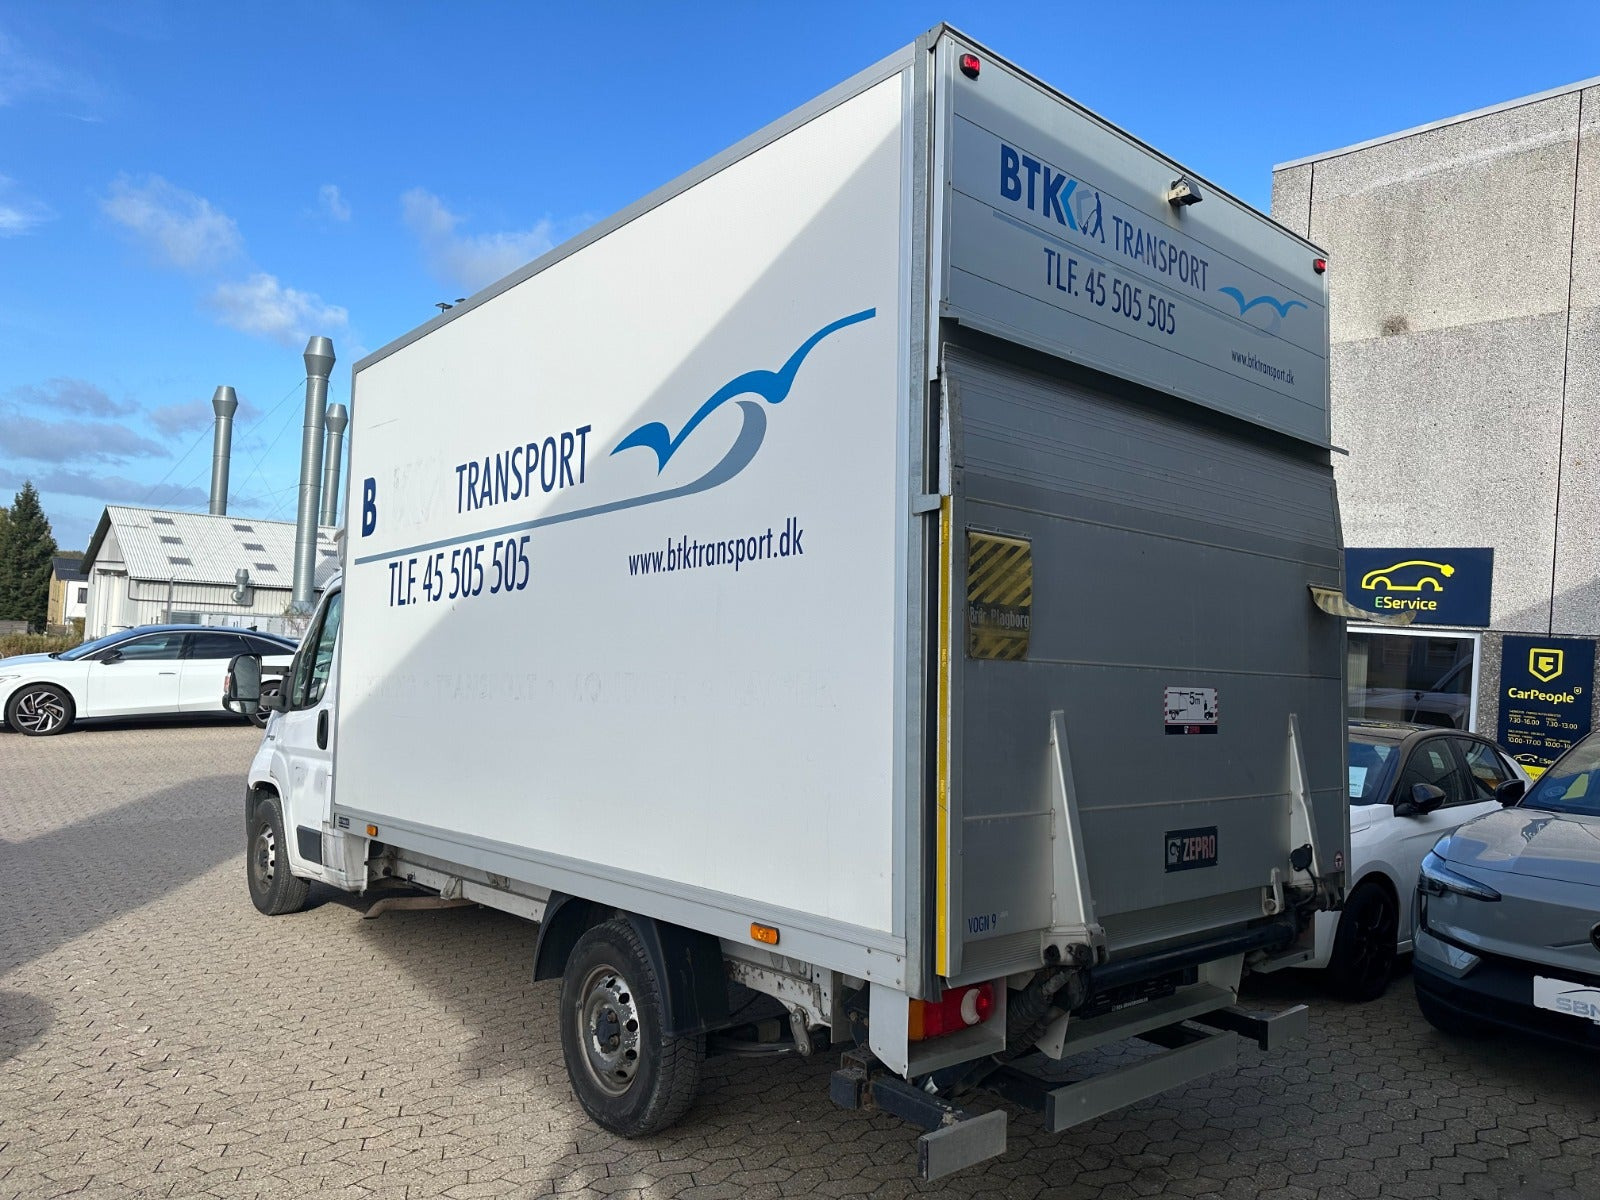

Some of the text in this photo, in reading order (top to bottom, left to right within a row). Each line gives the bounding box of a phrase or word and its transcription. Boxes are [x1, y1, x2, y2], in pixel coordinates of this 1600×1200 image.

[1000, 144, 1209, 292] BTK TRANSPORT
[1044, 247, 1176, 335] TLF. 45 505 505
[1231, 350, 1295, 386] www.btktransport.dk
[455, 424, 592, 514] TRANSPORT
[627, 516, 805, 577] www.btktransport.dk
[388, 535, 532, 607] TLF. 45 505 505
[1375, 596, 1437, 611] EService
[1508, 687, 1575, 705] CarPeople
[1182, 835, 1216, 862] ZEPRO
[967, 914, 990, 934] VOGN
[991, 913, 997, 930] 9
